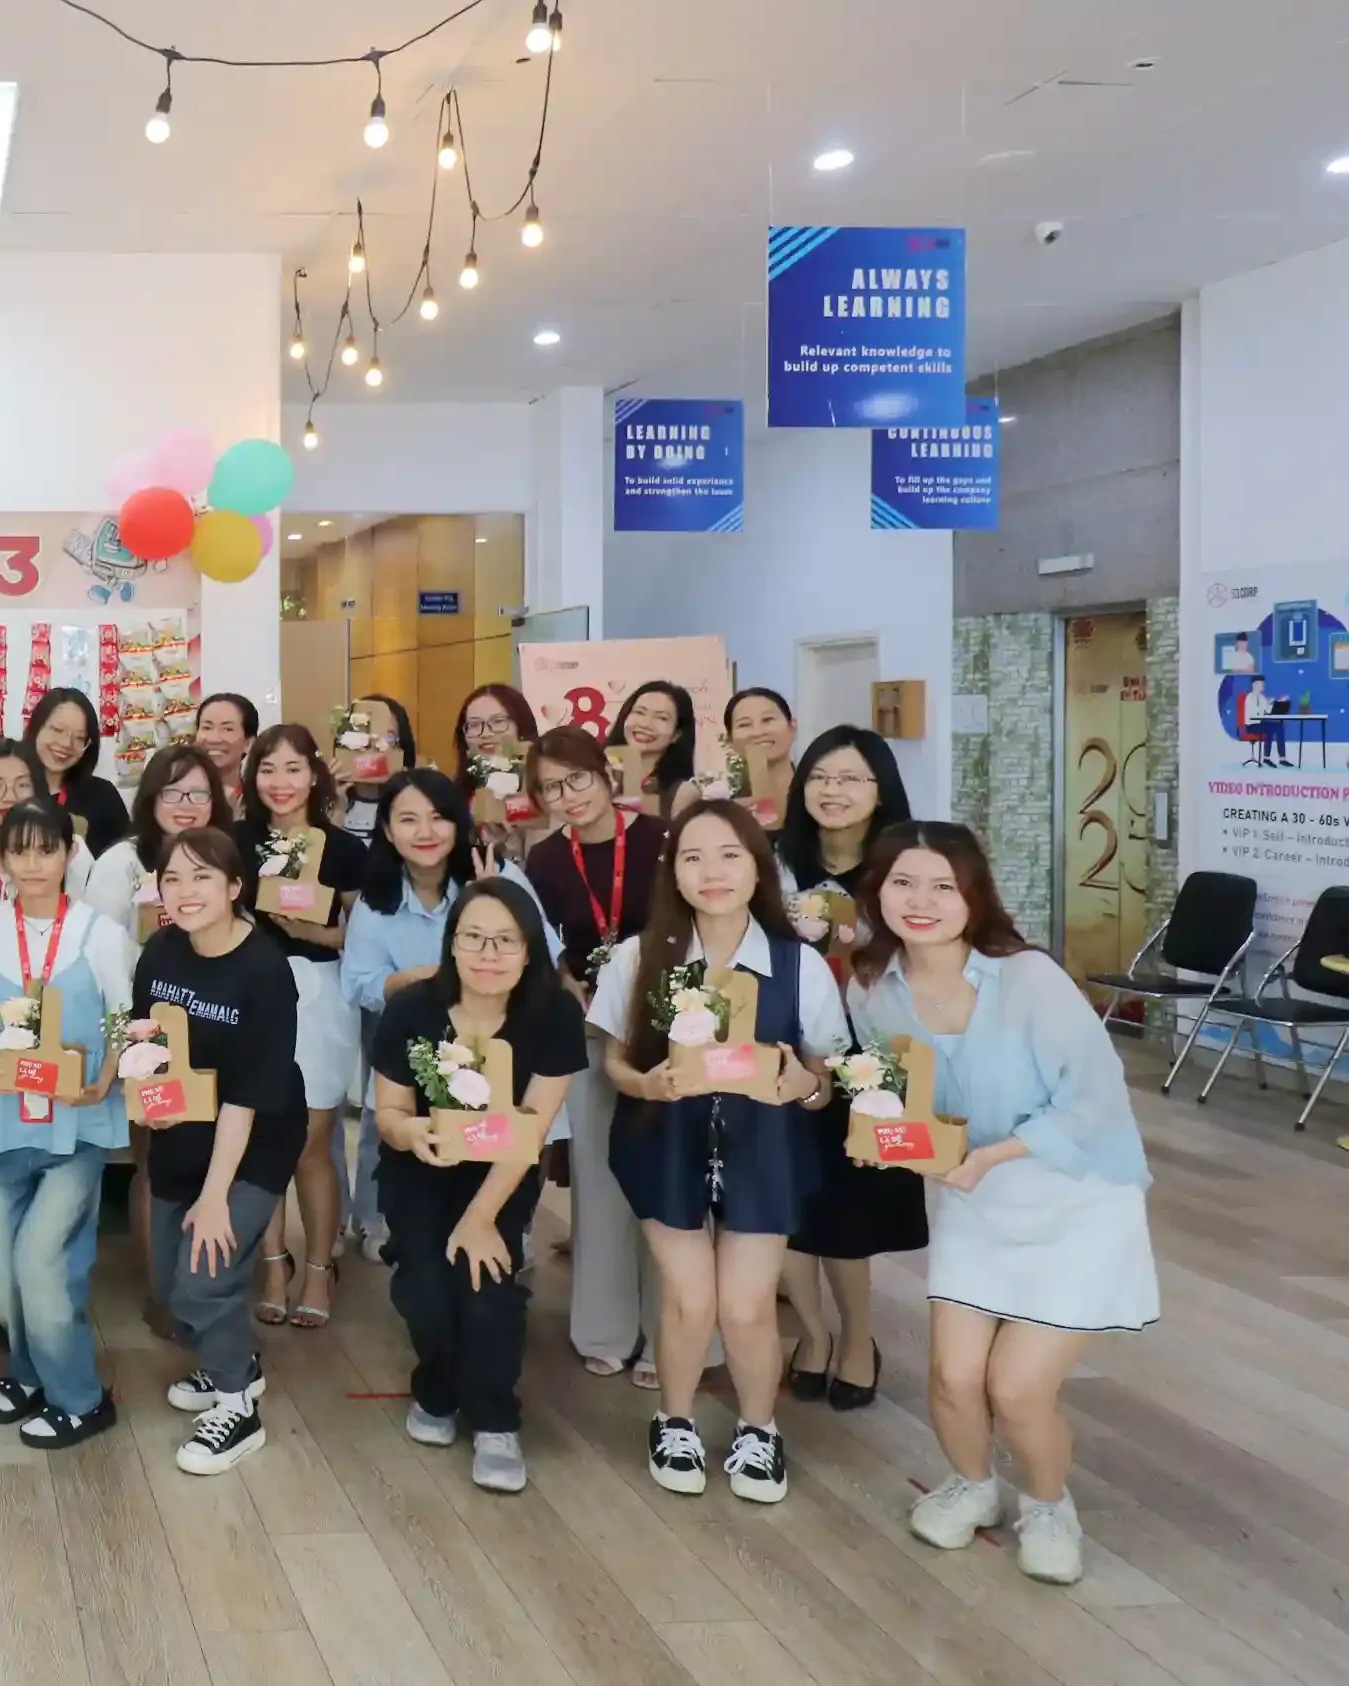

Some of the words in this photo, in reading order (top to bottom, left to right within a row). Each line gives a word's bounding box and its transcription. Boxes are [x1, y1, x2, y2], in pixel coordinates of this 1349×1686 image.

[852, 268, 949, 290] ALWAYS
[823, 295, 950, 318] LEARNING
[800, 344, 857, 357] Relevant
[861, 345, 933, 360] knowledge
[938, 346, 951, 358] to
[783, 360, 818, 372] build
[822, 363, 839, 375] up
[843, 362, 914, 375] competent
[918, 361, 952, 373] skills
[626, 424, 711, 440] LEARNING
[887, 425, 992, 440] CONTINUOUS
[626, 444, 646, 460] BY
[654, 444, 705, 460] DOING
[911, 442, 993, 458] LEARNING
[624, 476, 635, 485] To
[637, 476, 660, 485] build
[663, 476, 684, 485] solid
[686, 476, 734, 487] experience
[894, 476, 905, 484] To
[922, 477, 934, 486] up
[936, 476, 950, 484] the
[643, 487, 692, 498] strengthen
[694, 487, 709, 495] the
[922, 487, 934, 496] up
[922, 495, 958, 506] learning
[1208, 781, 1243, 795] VIDEO
[1246, 782, 1340, 800] INTRODUCTION
[1223, 808, 1277, 822] CREATING
[1281, 812, 1288, 823] A
[1292, 812, 1306, 824] 30
[1319, 814, 1340, 826] 60s
[1232, 828, 1250, 839] VIP
[1232, 846, 1250, 857] VIP
[1265, 848, 1302, 862] Career
